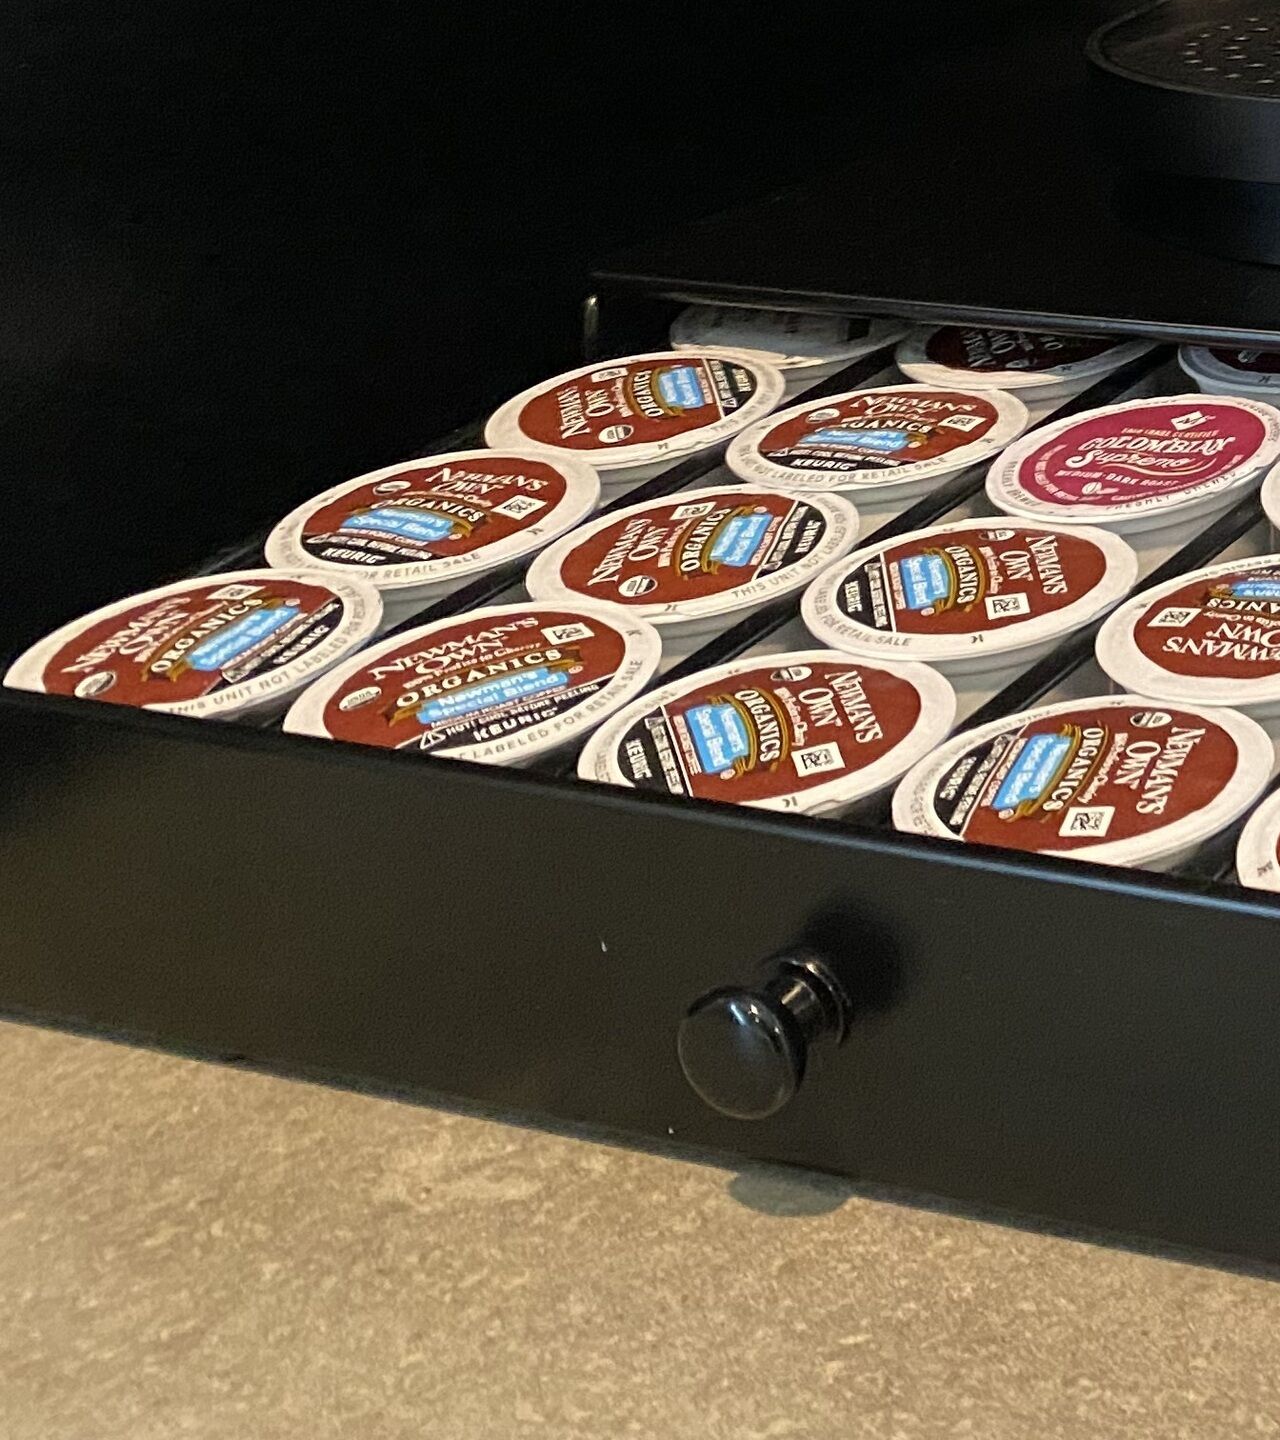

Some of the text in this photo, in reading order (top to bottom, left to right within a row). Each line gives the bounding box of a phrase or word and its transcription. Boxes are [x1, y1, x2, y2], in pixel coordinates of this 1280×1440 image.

[1065, 450, 1197, 469] Supremo
[1077, 436, 1236, 456] COLOMBIAN
[772, 466, 825, 483] LABELED
[828, 473, 855, 482] FOR
[861, 465, 910, 480] RETAIL
[321, 547, 383, 564] KEURIG
[680, 508, 731, 572] ORGANICS
[385, 552, 481, 578] RETAIL SALE
[731, 555, 822, 599] THIS UNIT NOT
[944, 546, 978, 604] ORGANICS
[150, 598, 263, 674] ORGANICS
[368, 617, 540, 681] NEWMAN'S
[835, 621, 912, 647] RETAIL SALE
[415, 640, 506, 676] OWN
[212, 685, 252, 709] UNIT
[259, 669, 292, 690] NOT
[395, 648, 563, 709] ORGANICS
[437, 671, 538, 707] Newman's
[554, 683, 601, 701] PEELING
[427, 692, 501, 719] Special
[472, 707, 553, 742] KEURIG
[477, 659, 643, 760] LABELED FOR RETAIL SALE
[734, 688, 781, 763] ORGANICS
[798, 686, 839, 729] OWN
[625, 738, 653, 781] KEURIG
[1041, 726, 1105, 812] ORGANICS
